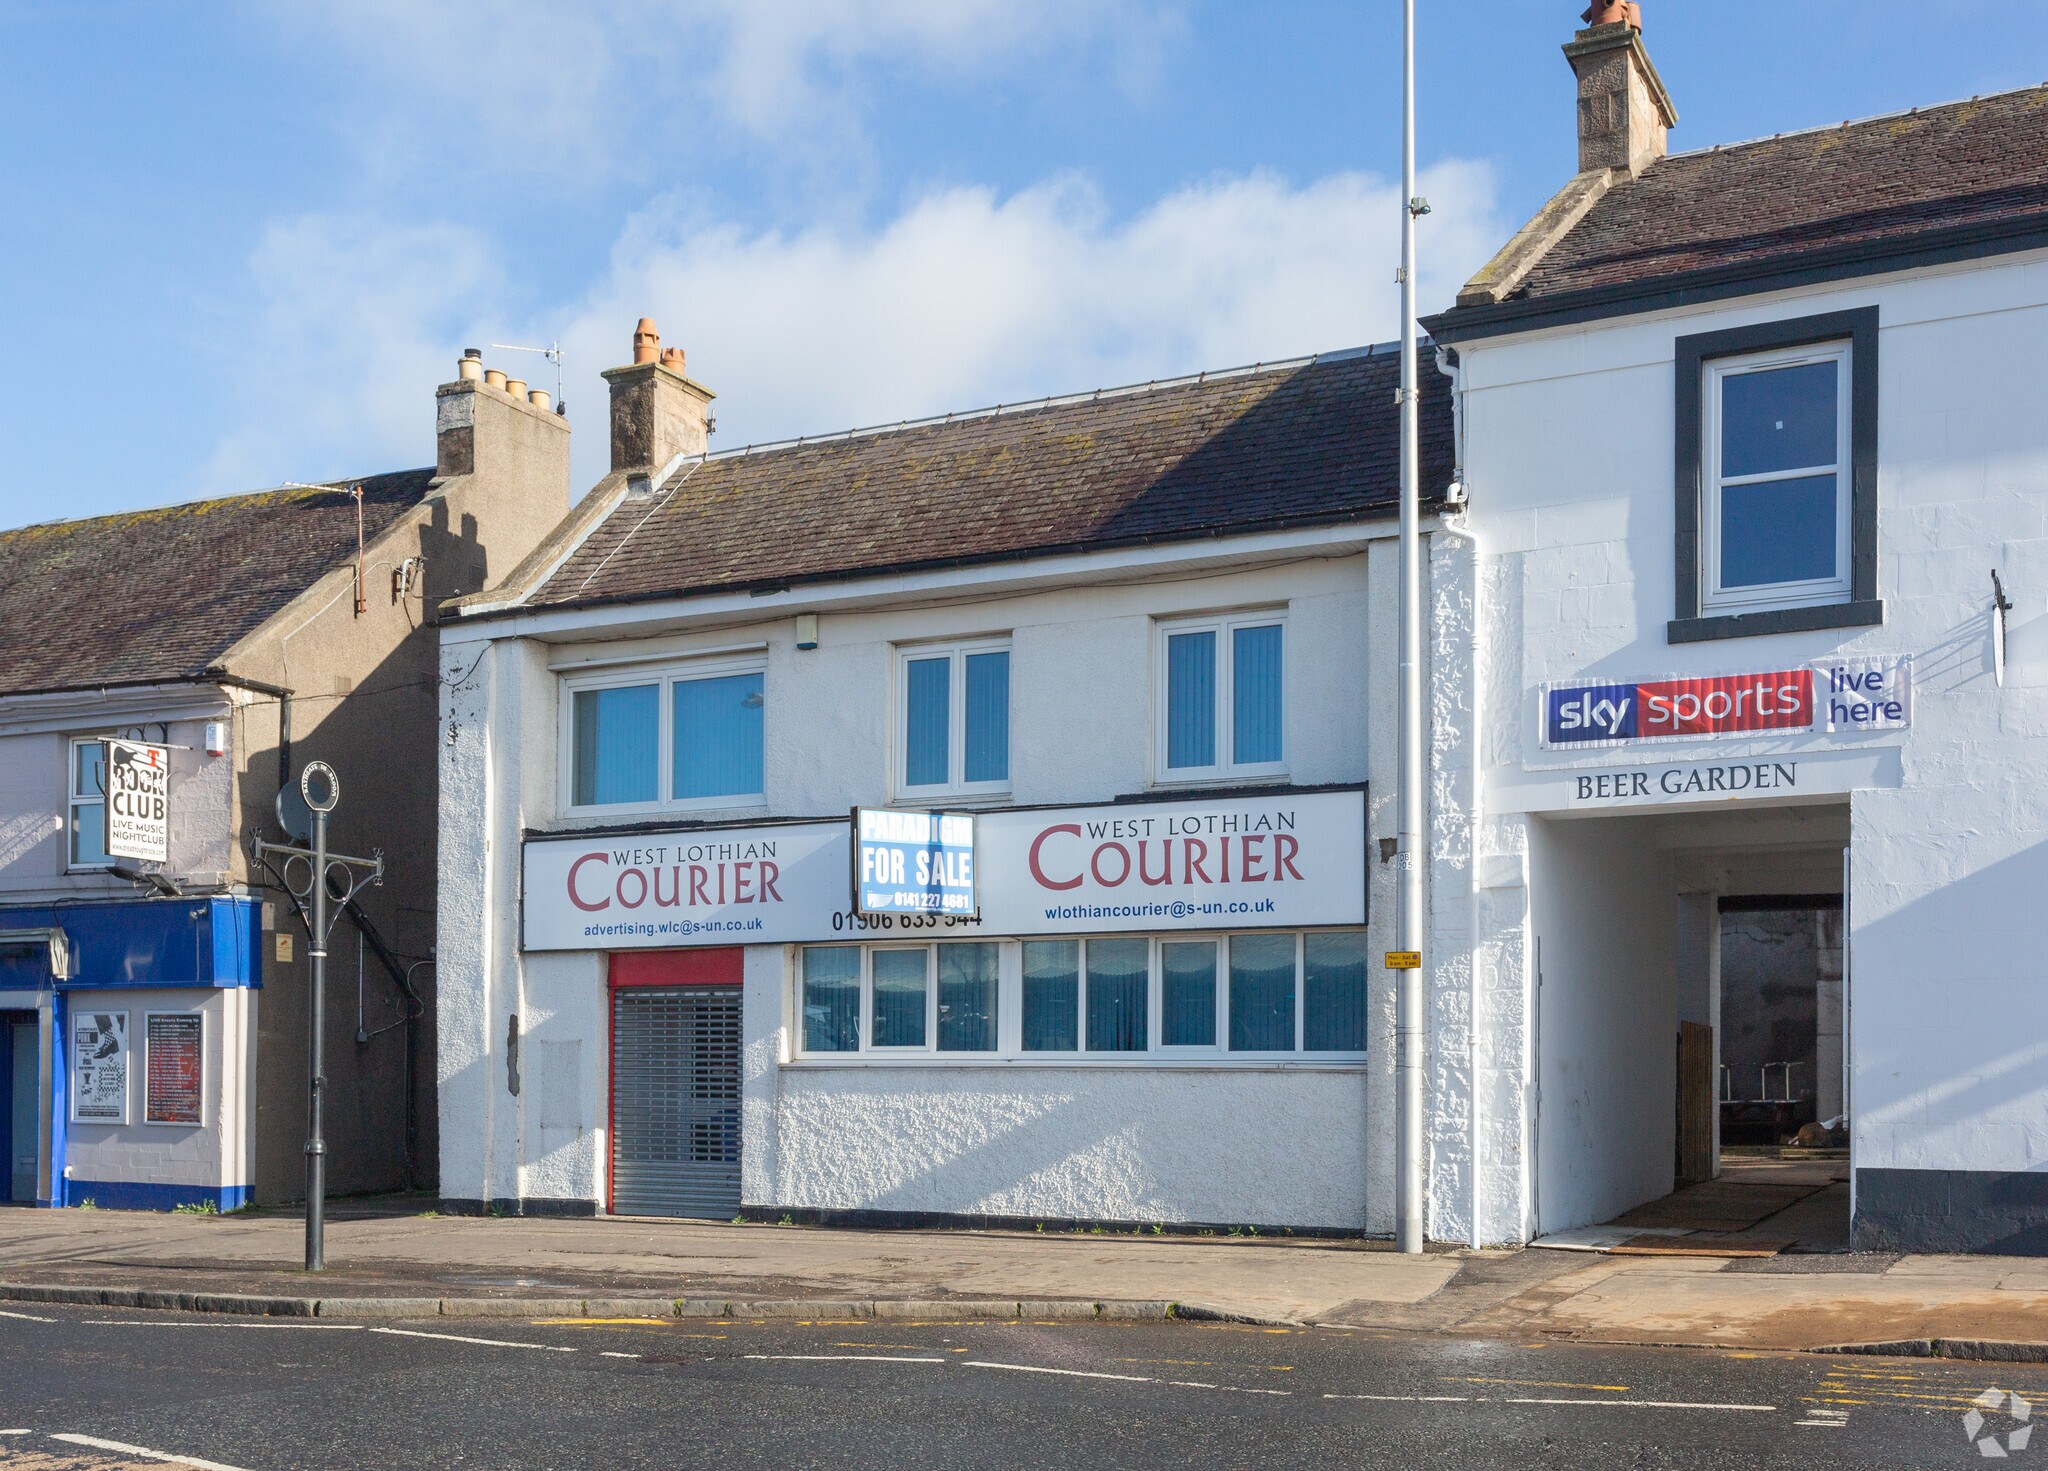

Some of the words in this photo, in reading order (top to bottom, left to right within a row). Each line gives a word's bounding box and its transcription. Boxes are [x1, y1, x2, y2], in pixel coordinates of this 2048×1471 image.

[1830, 667, 1883, 693] live
[1559, 691, 1631, 735] sky
[1647, 682, 1801, 730] sports
[1830, 697, 1902, 723] here
[147, 749, 160, 768] T
[113, 764, 164, 796] ROCK
[1576, 773, 1651, 800] BEER
[1660, 762, 1797, 794] GARDEN
[113, 791, 164, 820] CLUB
[112, 820, 132, 830] LIVE
[136, 823, 164, 834] MUSIC
[112, 830, 164, 844] NIGHTCLUB
[862, 811, 969, 844] PARADIGM
[1087, 819, 1154, 840] WEST
[1170, 811, 1297, 835] LOTHIAN
[613, 845, 666, 866] WEST
[678, 841, 777, 862] LOTHIAN
[862, 847, 905, 884] FOR
[916, 850, 972, 887] SALE
[1028, 823, 1305, 891] COURIER
[567, 852, 784, 911] COURIER
[895, 892, 919, 907] 0141
[921, 894, 940, 907] 227
[1044, 898, 1275, 920] wlothiancourier@s-un.co.uk
[584, 918, 763, 938] advertising.wlc@s-un.co.uk
